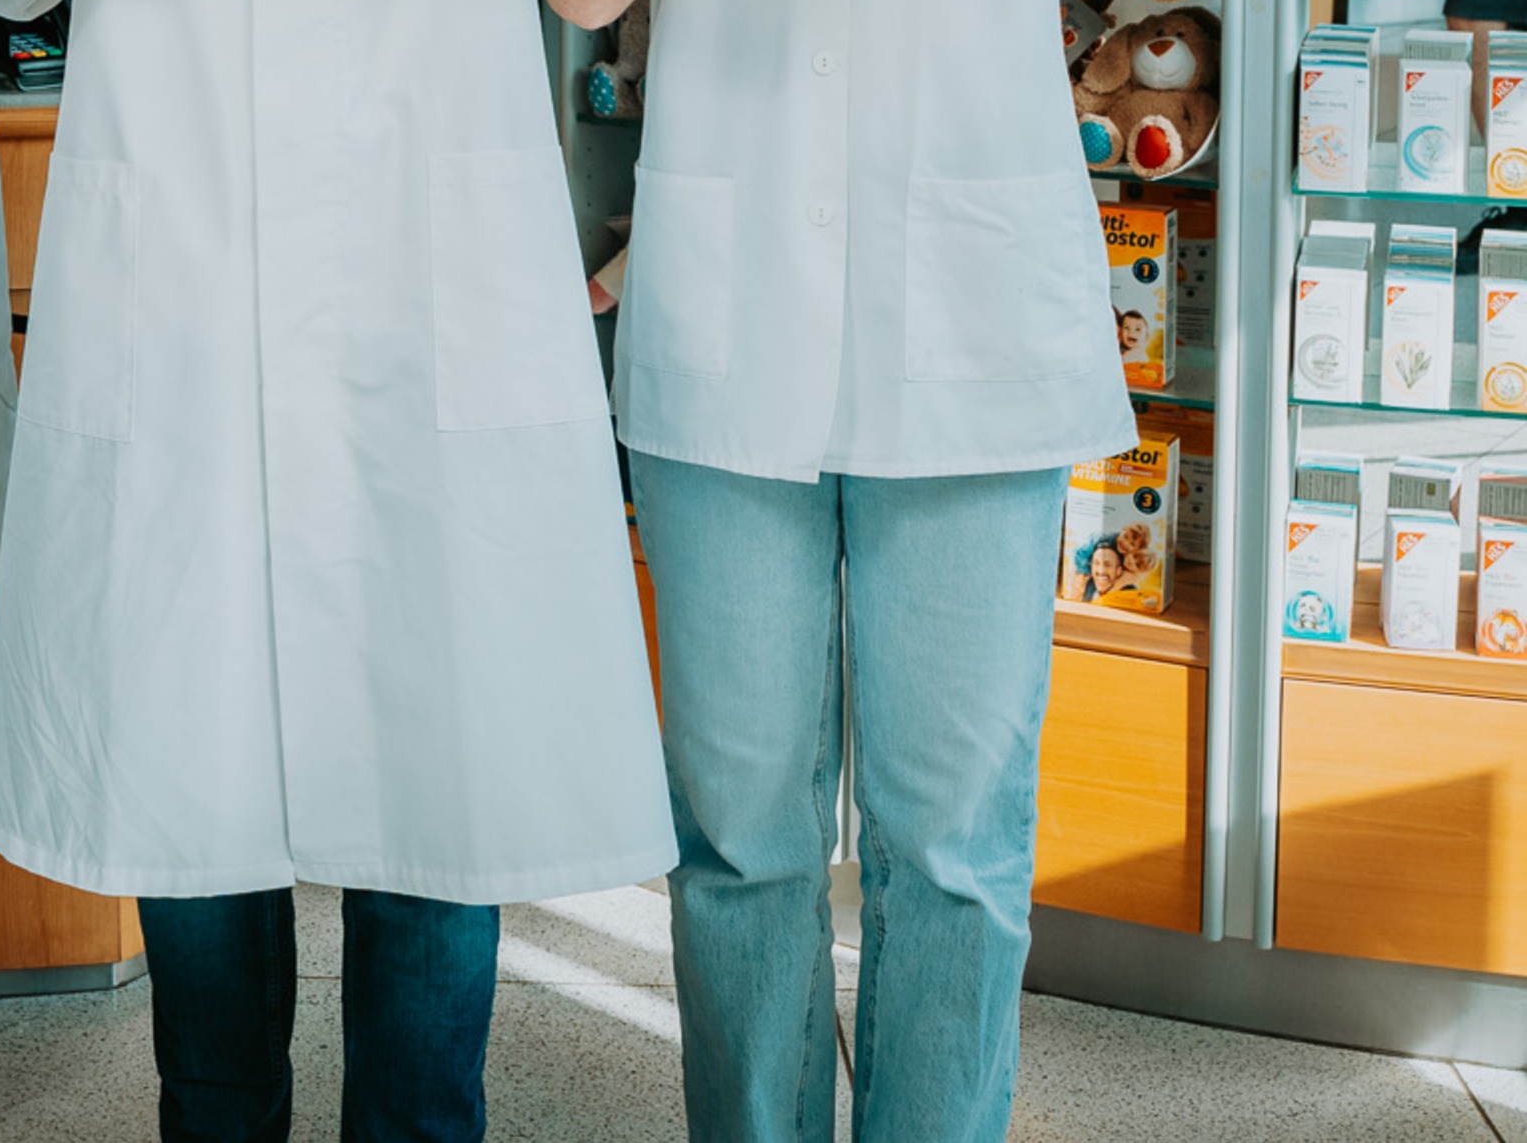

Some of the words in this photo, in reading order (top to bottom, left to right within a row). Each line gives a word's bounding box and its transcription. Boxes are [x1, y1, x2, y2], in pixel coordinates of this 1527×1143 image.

[1103, 214, 1129, 231] lti-
[1106, 231, 1155, 249] ostol
[1141, 263, 1151, 278] 1
[1072, 469, 1132, 487] VITAMINE
[1141, 493, 1153, 508] 3
